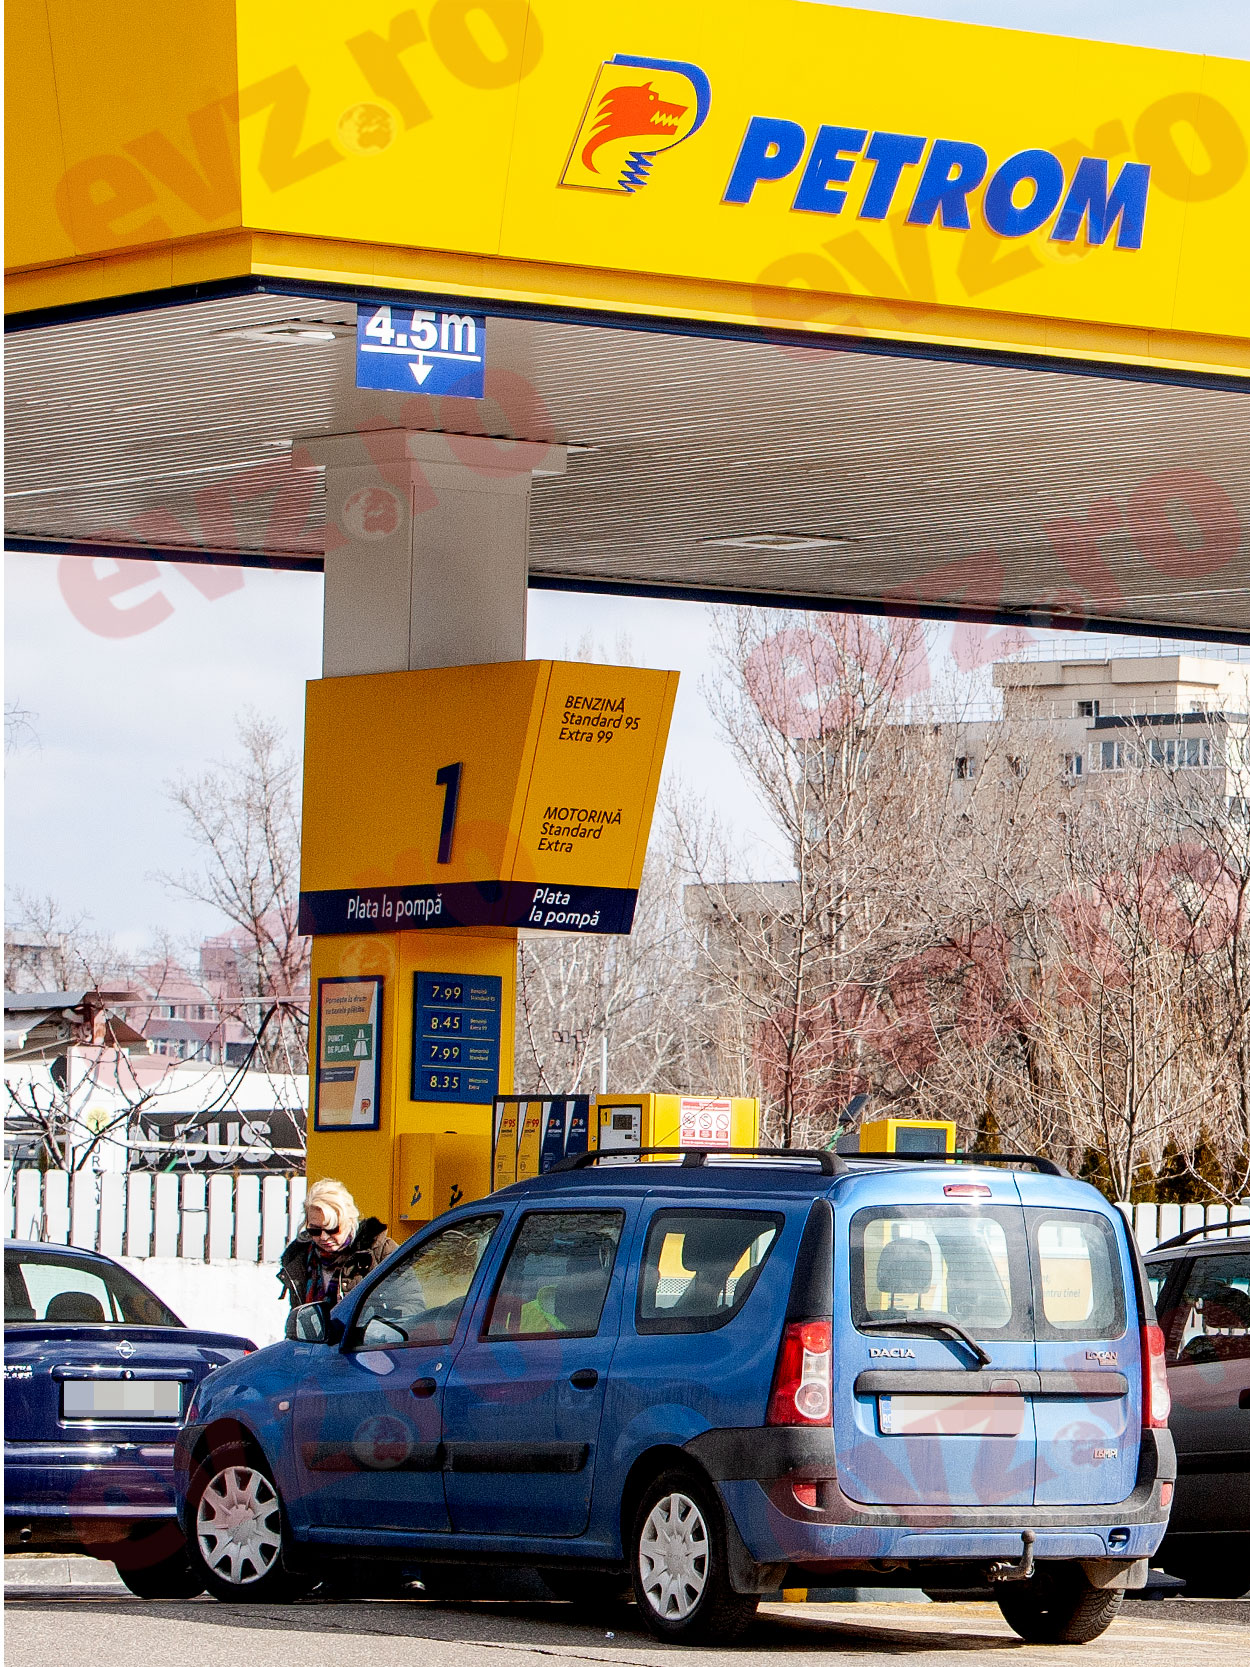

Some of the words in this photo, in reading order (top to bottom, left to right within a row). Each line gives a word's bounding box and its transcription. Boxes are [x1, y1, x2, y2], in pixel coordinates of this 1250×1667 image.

[721, 115, 1152, 252] PETROM
[366, 305, 477, 355] 4.5m
[565, 694, 627, 713] BENZINĂ
[562, 711, 623, 729] Standard
[625, 717, 641, 730] 95
[559, 727, 594, 743] Extra
[597, 730, 613, 744] 99
[436, 762, 463, 864] 1
[543, 807, 623, 825] MOTORINĂ
[541, 822, 604, 840] Standard
[538, 837, 573, 853] Extra
[533, 887, 571, 906] Plata
[347, 895, 379, 920] Plata
[382, 893, 393, 918] la
[396, 892, 443, 923] pompă
[528, 905, 542, 922] la
[545, 909, 601, 929] pompă
[432, 985, 462, 1000] 7.99
[430, 1017, 461, 1030] 8.45
[327, 1034, 344, 1043] PUNCT
[327, 1046, 335, 1054] DE
[430, 1045, 460, 1060] 7.99
[429, 1075, 459, 1089] 8.35
[509, 1119, 516, 1127] 95
[532, 1118, 539, 1127] 99
[604, 1112, 608, 1122] 1
[870, 1348, 916, 1358] DACIA
